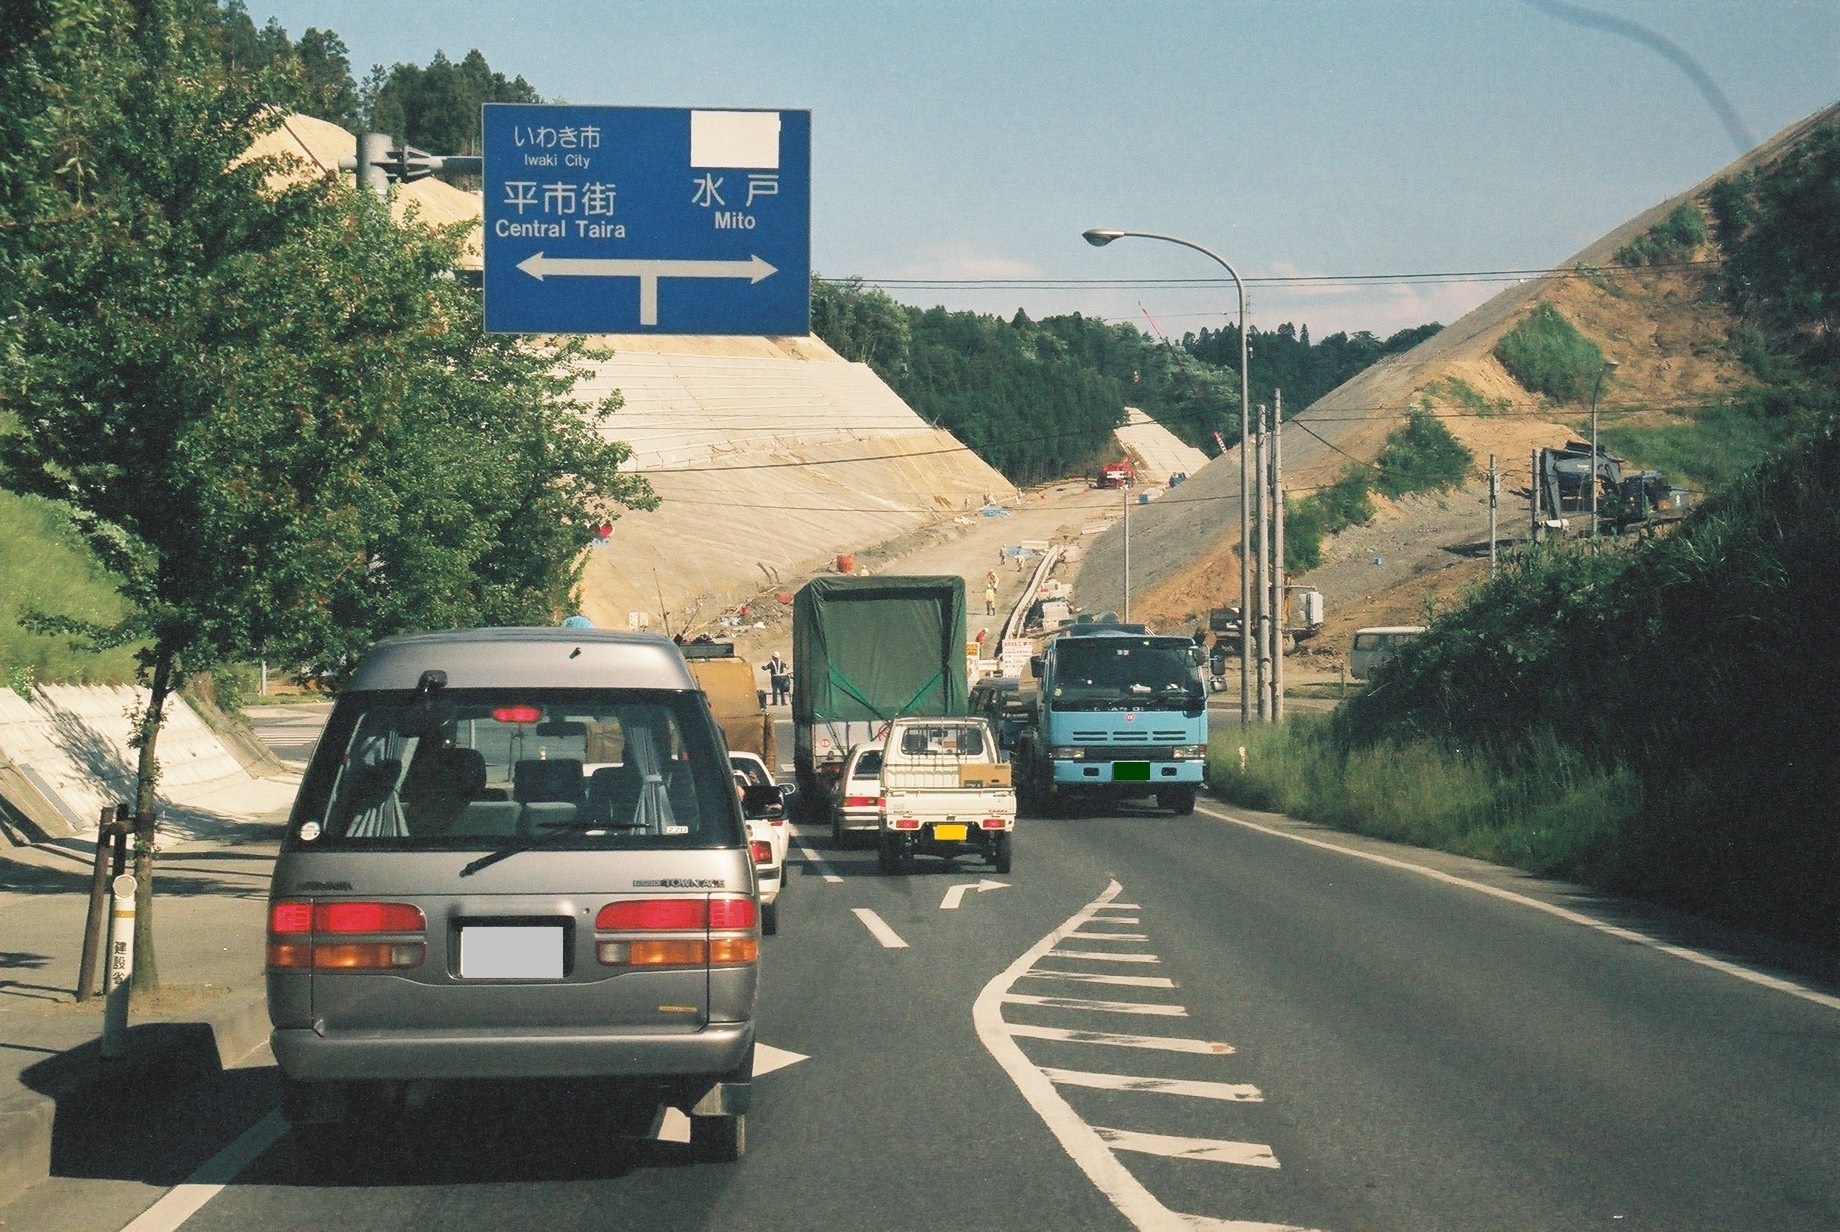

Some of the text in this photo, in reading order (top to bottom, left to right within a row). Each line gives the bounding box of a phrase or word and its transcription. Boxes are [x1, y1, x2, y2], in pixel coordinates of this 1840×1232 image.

[514, 125, 601, 149] いわき市
[524, 154, 591, 170] Iwaki City
[504, 181, 617, 216] 平市街
[691, 172, 779, 207] 水戸
[495, 219, 626, 238] Central Taira
[714, 211, 756, 230] Mito
[112, 941, 128, 985] 建設省
